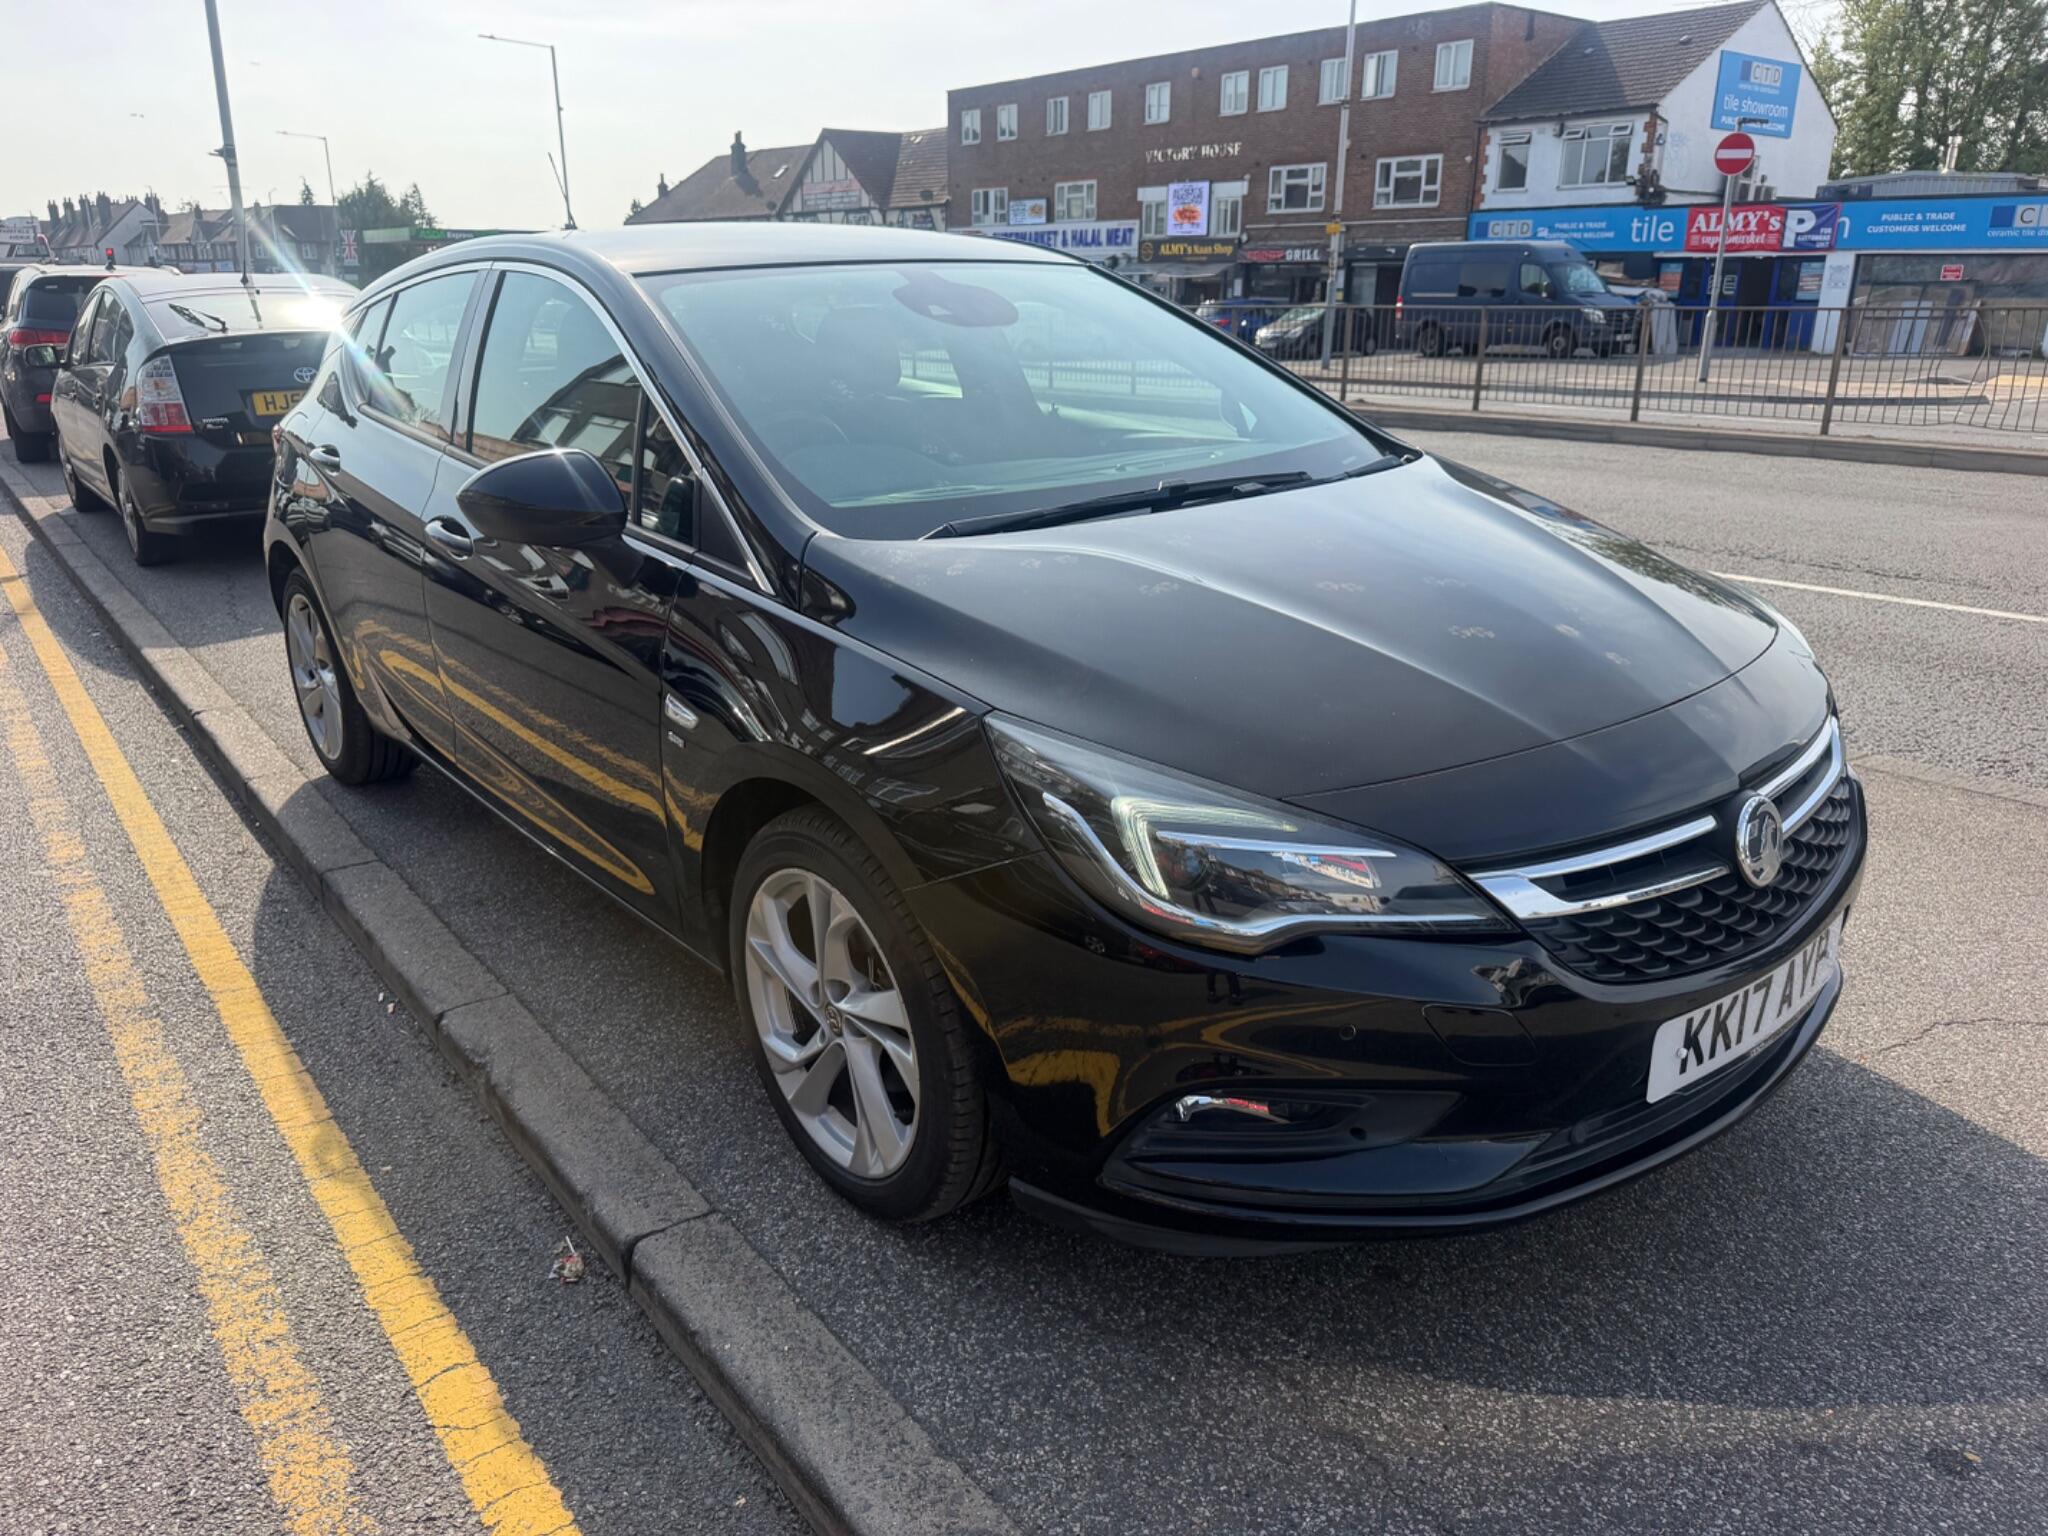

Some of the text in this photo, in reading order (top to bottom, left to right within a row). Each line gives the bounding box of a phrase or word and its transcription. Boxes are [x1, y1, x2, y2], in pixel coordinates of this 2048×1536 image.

[1752, 64, 1781, 84] CTD
[1723, 94, 1788, 118] tile showroom
[1145, 142, 1242, 163] VICTORY HOUSE
[1690, 210, 1781, 233] ALMY's
[1881, 211, 1956, 222] PUBLIC & TRADE
[1061, 229, 1069, 248] &
[1071, 228, 1103, 249] HALAL
[1106, 227, 1135, 247] MEAT
[1490, 222, 1531, 237] CTD
[1630, 214, 1675, 243] tile
[1782, 209, 1817, 248] P
[1866, 223, 1967, 234] CUSTOMERS WELCOME
[1285, 248, 1320, 261] GRILL
[1679, 974, 1775, 1076] KK17
